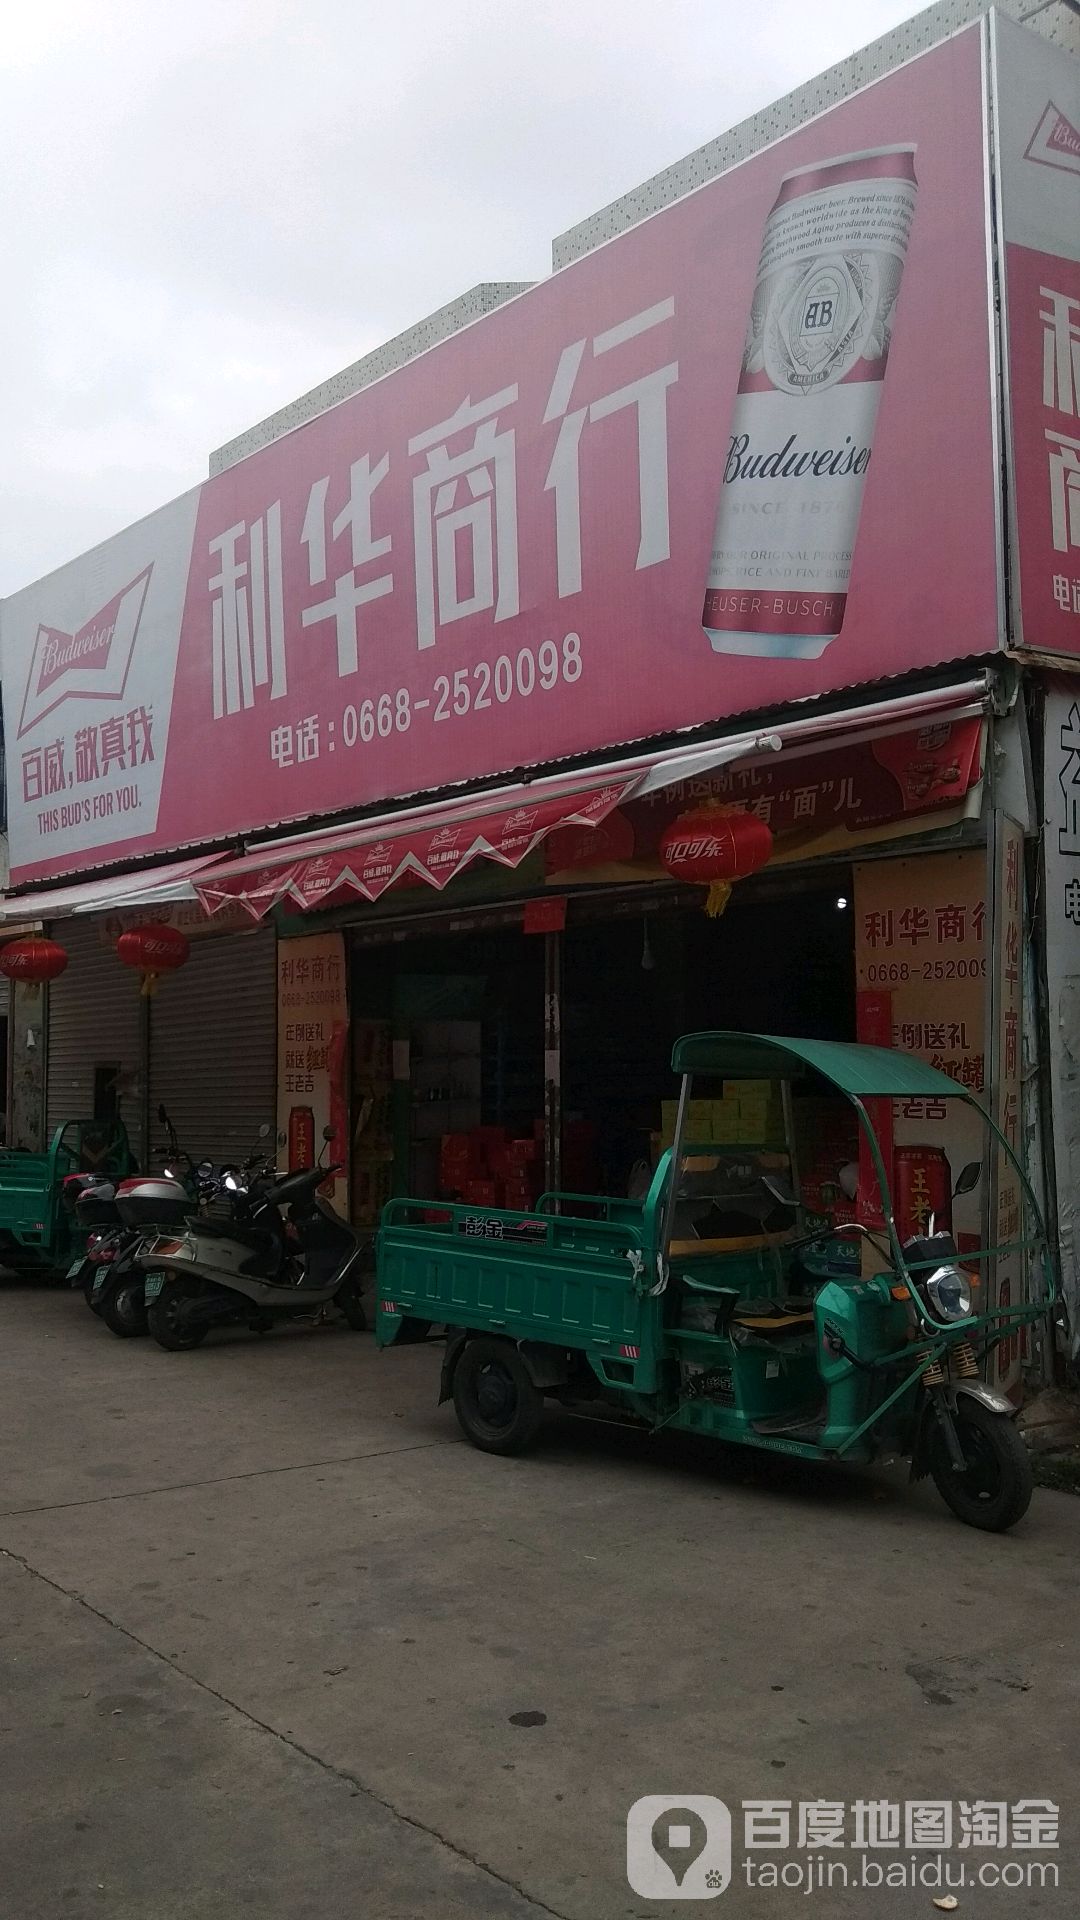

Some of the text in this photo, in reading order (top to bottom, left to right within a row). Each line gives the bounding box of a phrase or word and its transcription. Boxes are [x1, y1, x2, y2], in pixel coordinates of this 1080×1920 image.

[791, 203, 827, 221] Budweiser
[848, 193, 876, 205] Brewed
[806, 209, 848, 227] worldwide
[862, 205, 875, 215] the
[796, 238, 823, 253] smooth
[824, 233, 844, 244] taste
[845, 230, 862, 240] with
[863, 231, 891, 241] superior
[812, 224, 834, 239] Aging
[835, 219, 871, 233] produces
[804, 299, 834, 329] AB
[722, 433, 872, 485] Budweiser
[208, 295, 679, 721] 利华商行
[750, 550, 809, 562] ORIGINAL
[735, 567, 764, 577] RICE
[764, 567, 793, 578] AND
[41, 622, 116, 678] Budweiser
[37, 784, 143, 836] THIS BUD'S FOR YOU.
[663, 834, 728, 864] 可口可乐
[281, 954, 341, 985] 利华商行
[285, 1074, 315, 1093] 王老吉
